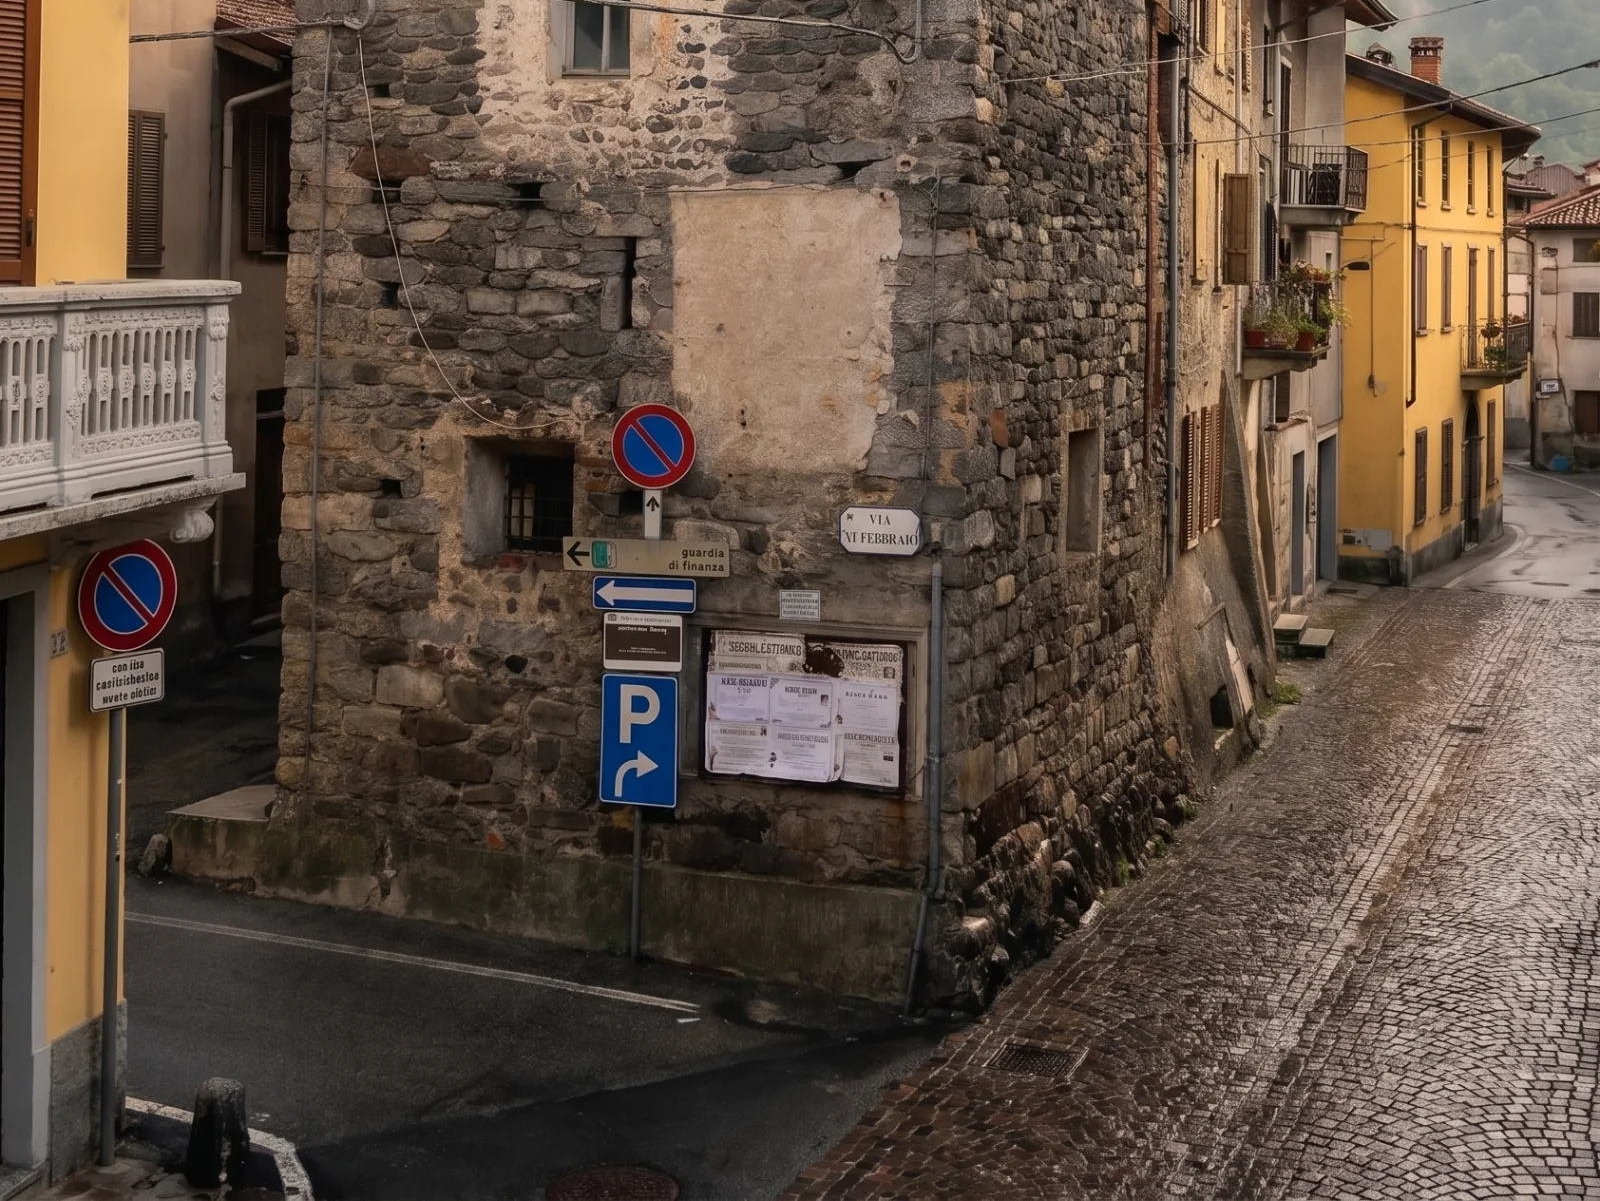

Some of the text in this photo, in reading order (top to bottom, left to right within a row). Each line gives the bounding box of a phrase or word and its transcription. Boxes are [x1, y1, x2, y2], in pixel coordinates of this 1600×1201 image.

[870, 514, 891, 525] VIA
[861, 532, 918, 545] FEBBRAIO
[682, 548, 724, 559] guardia
[668, 560, 725, 572] di finanza
[619, 683, 660, 744] P
